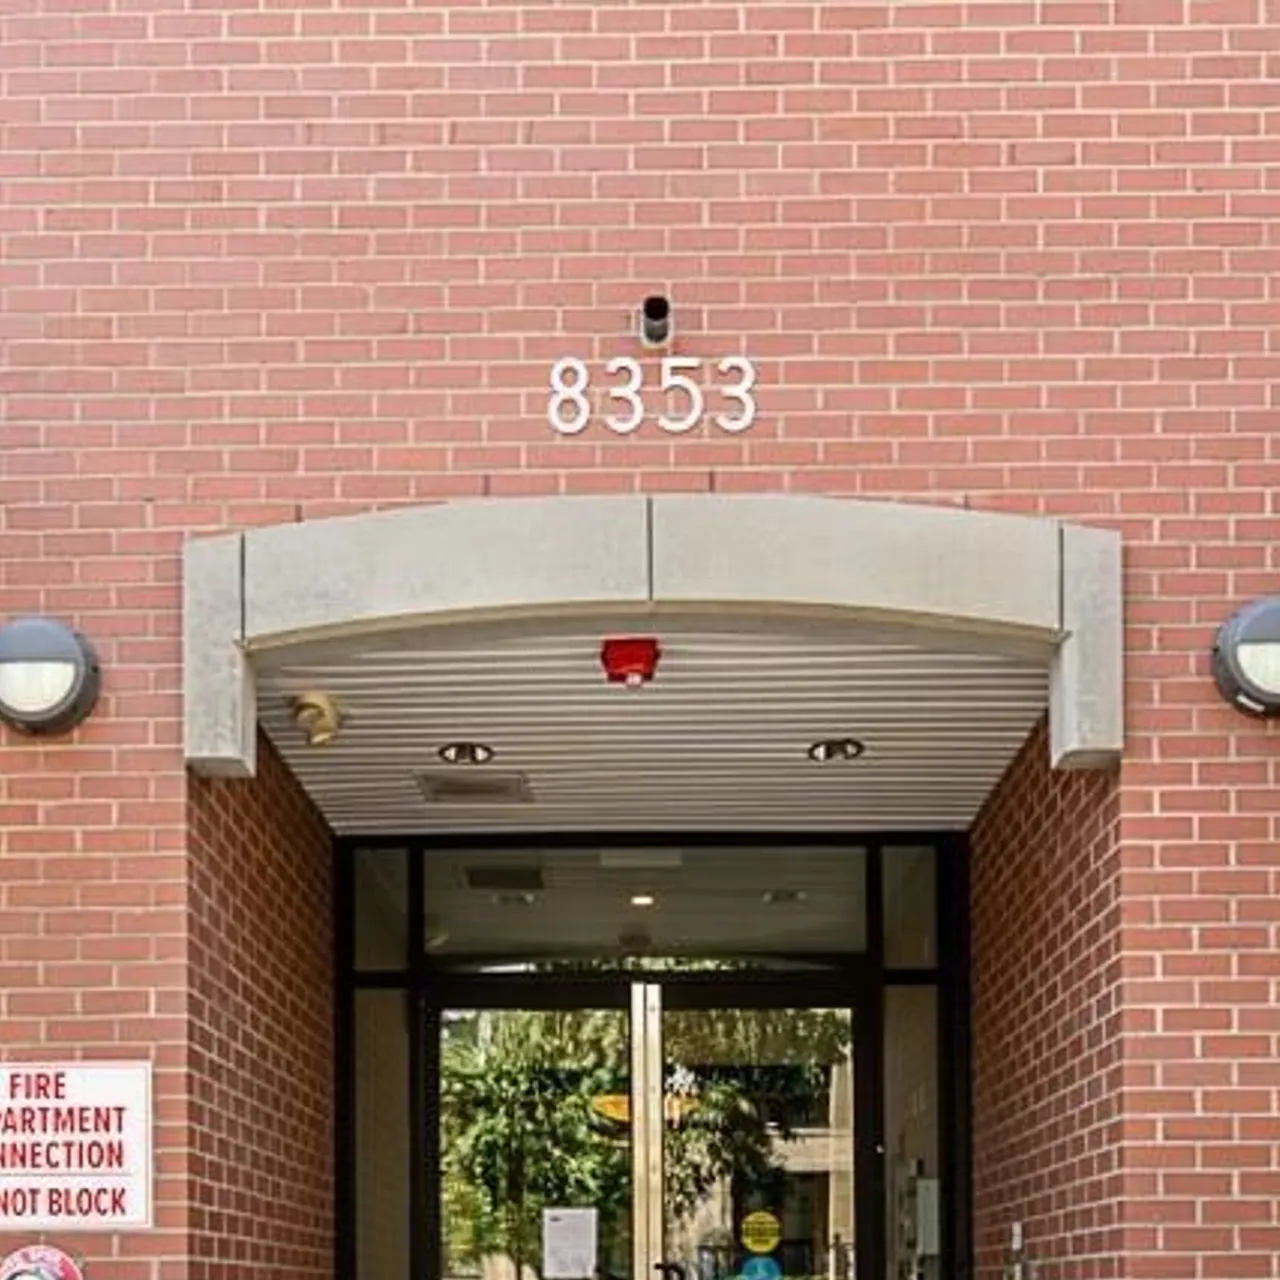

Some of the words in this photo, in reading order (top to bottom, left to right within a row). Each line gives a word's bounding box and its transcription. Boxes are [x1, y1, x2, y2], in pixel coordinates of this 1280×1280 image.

[548, 356, 757, 434] 8353
[9, 1072, 67, 1099] FIRE
[48, 1188, 127, 1216] BLOCK
